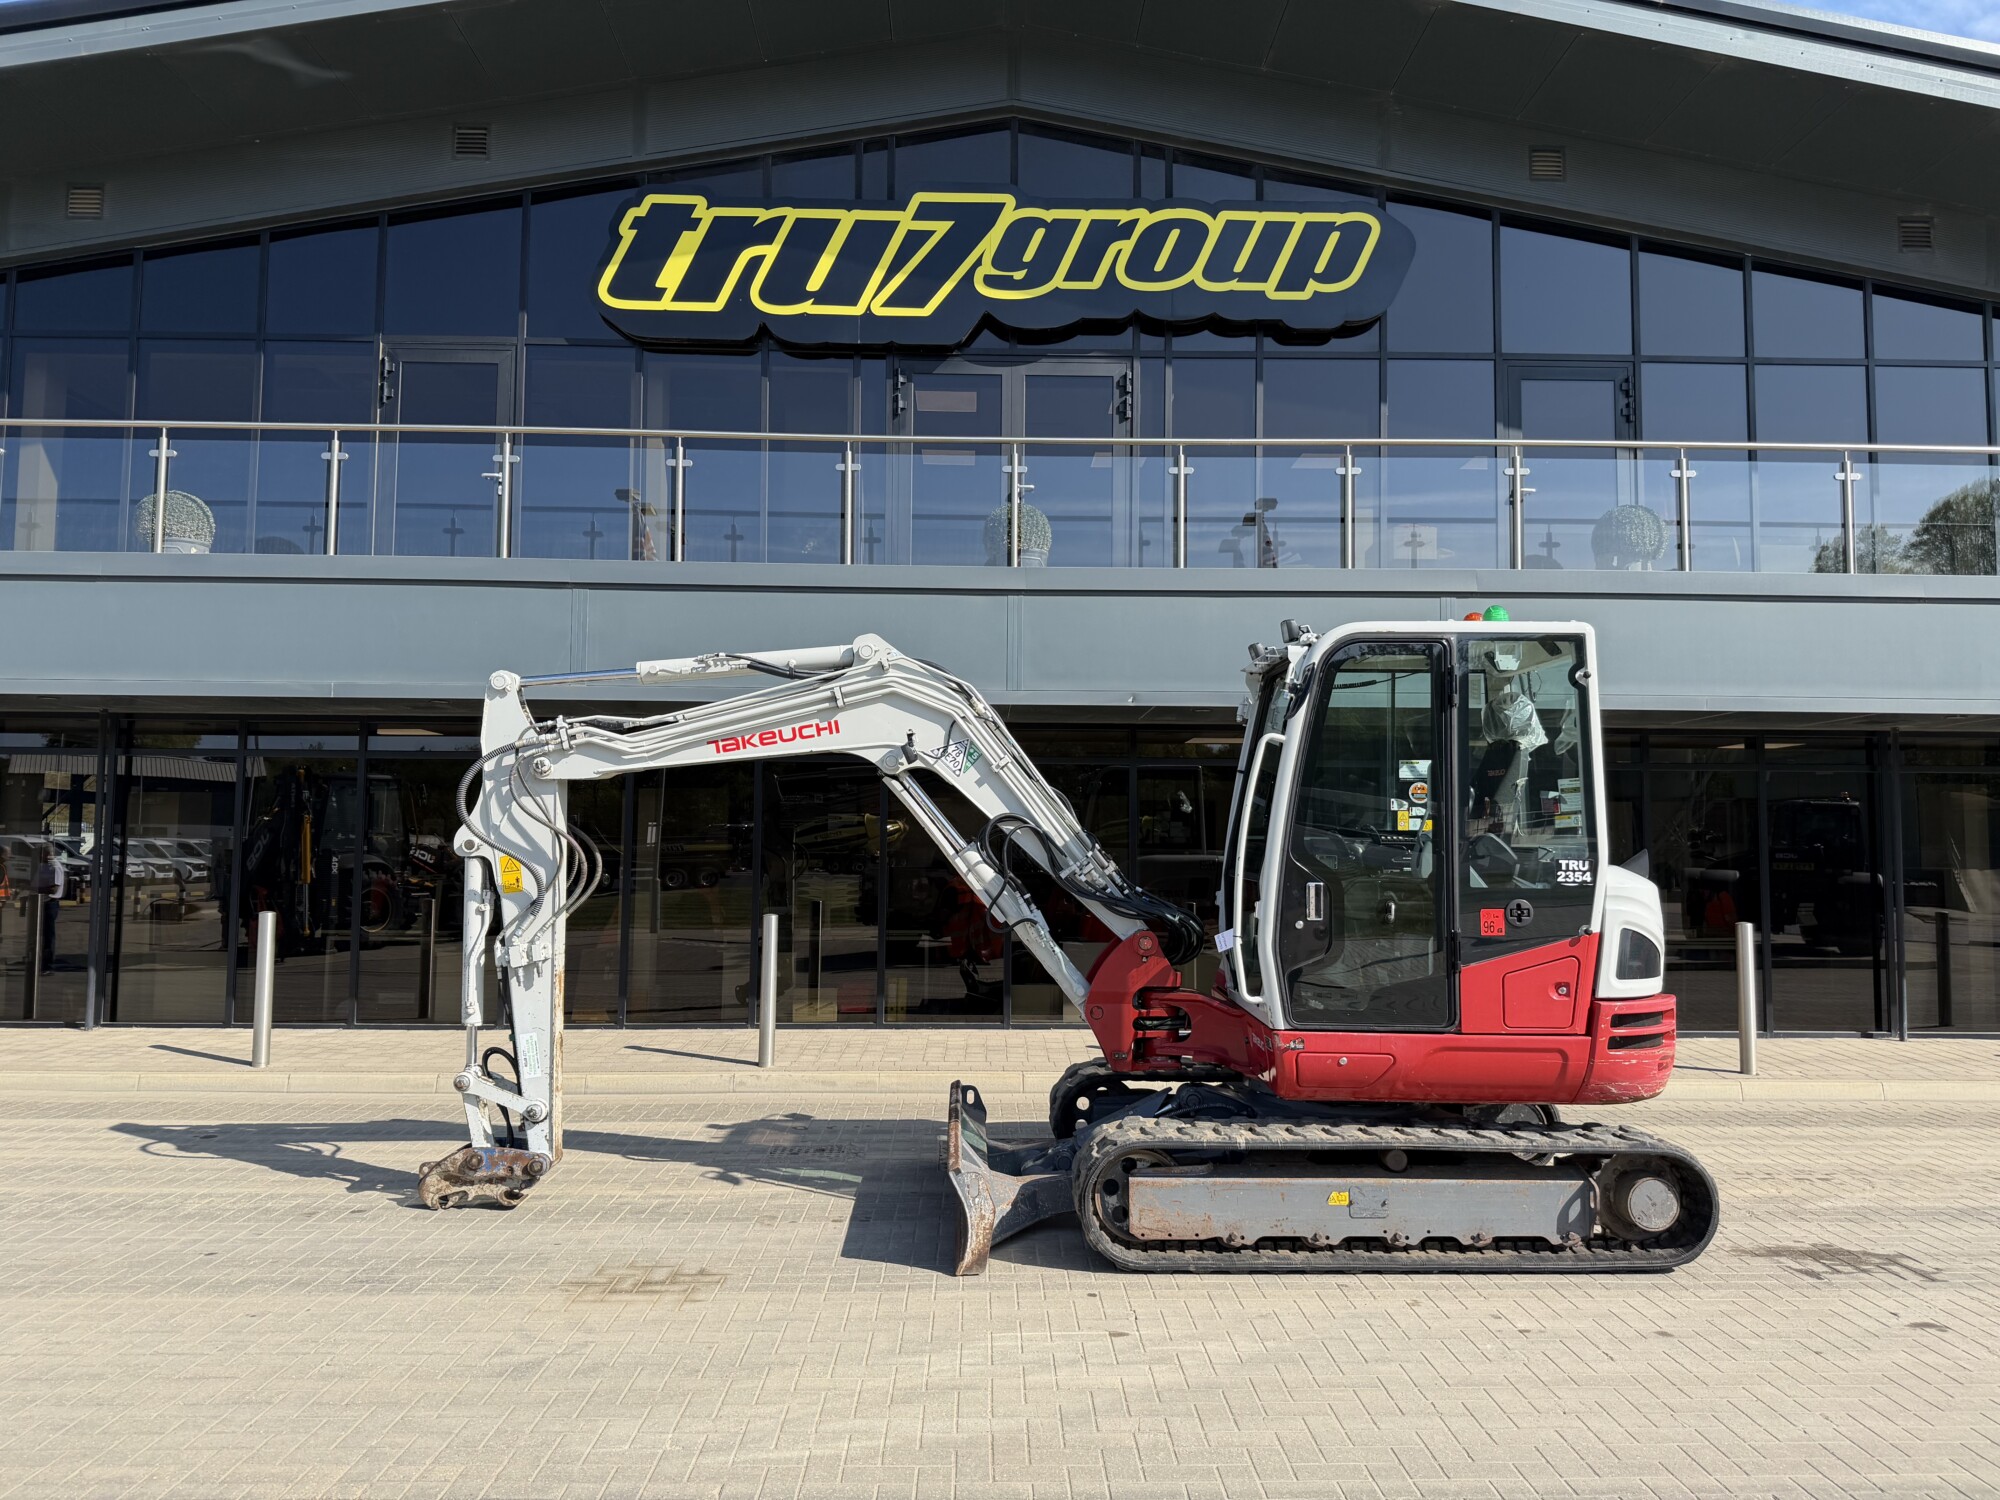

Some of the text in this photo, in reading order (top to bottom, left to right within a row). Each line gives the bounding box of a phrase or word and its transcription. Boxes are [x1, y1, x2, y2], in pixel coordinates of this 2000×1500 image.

[1559, 860, 1589, 871] TRU
[1557, 871, 1592, 882] 2354
[1483, 920, 1495, 934] 96
